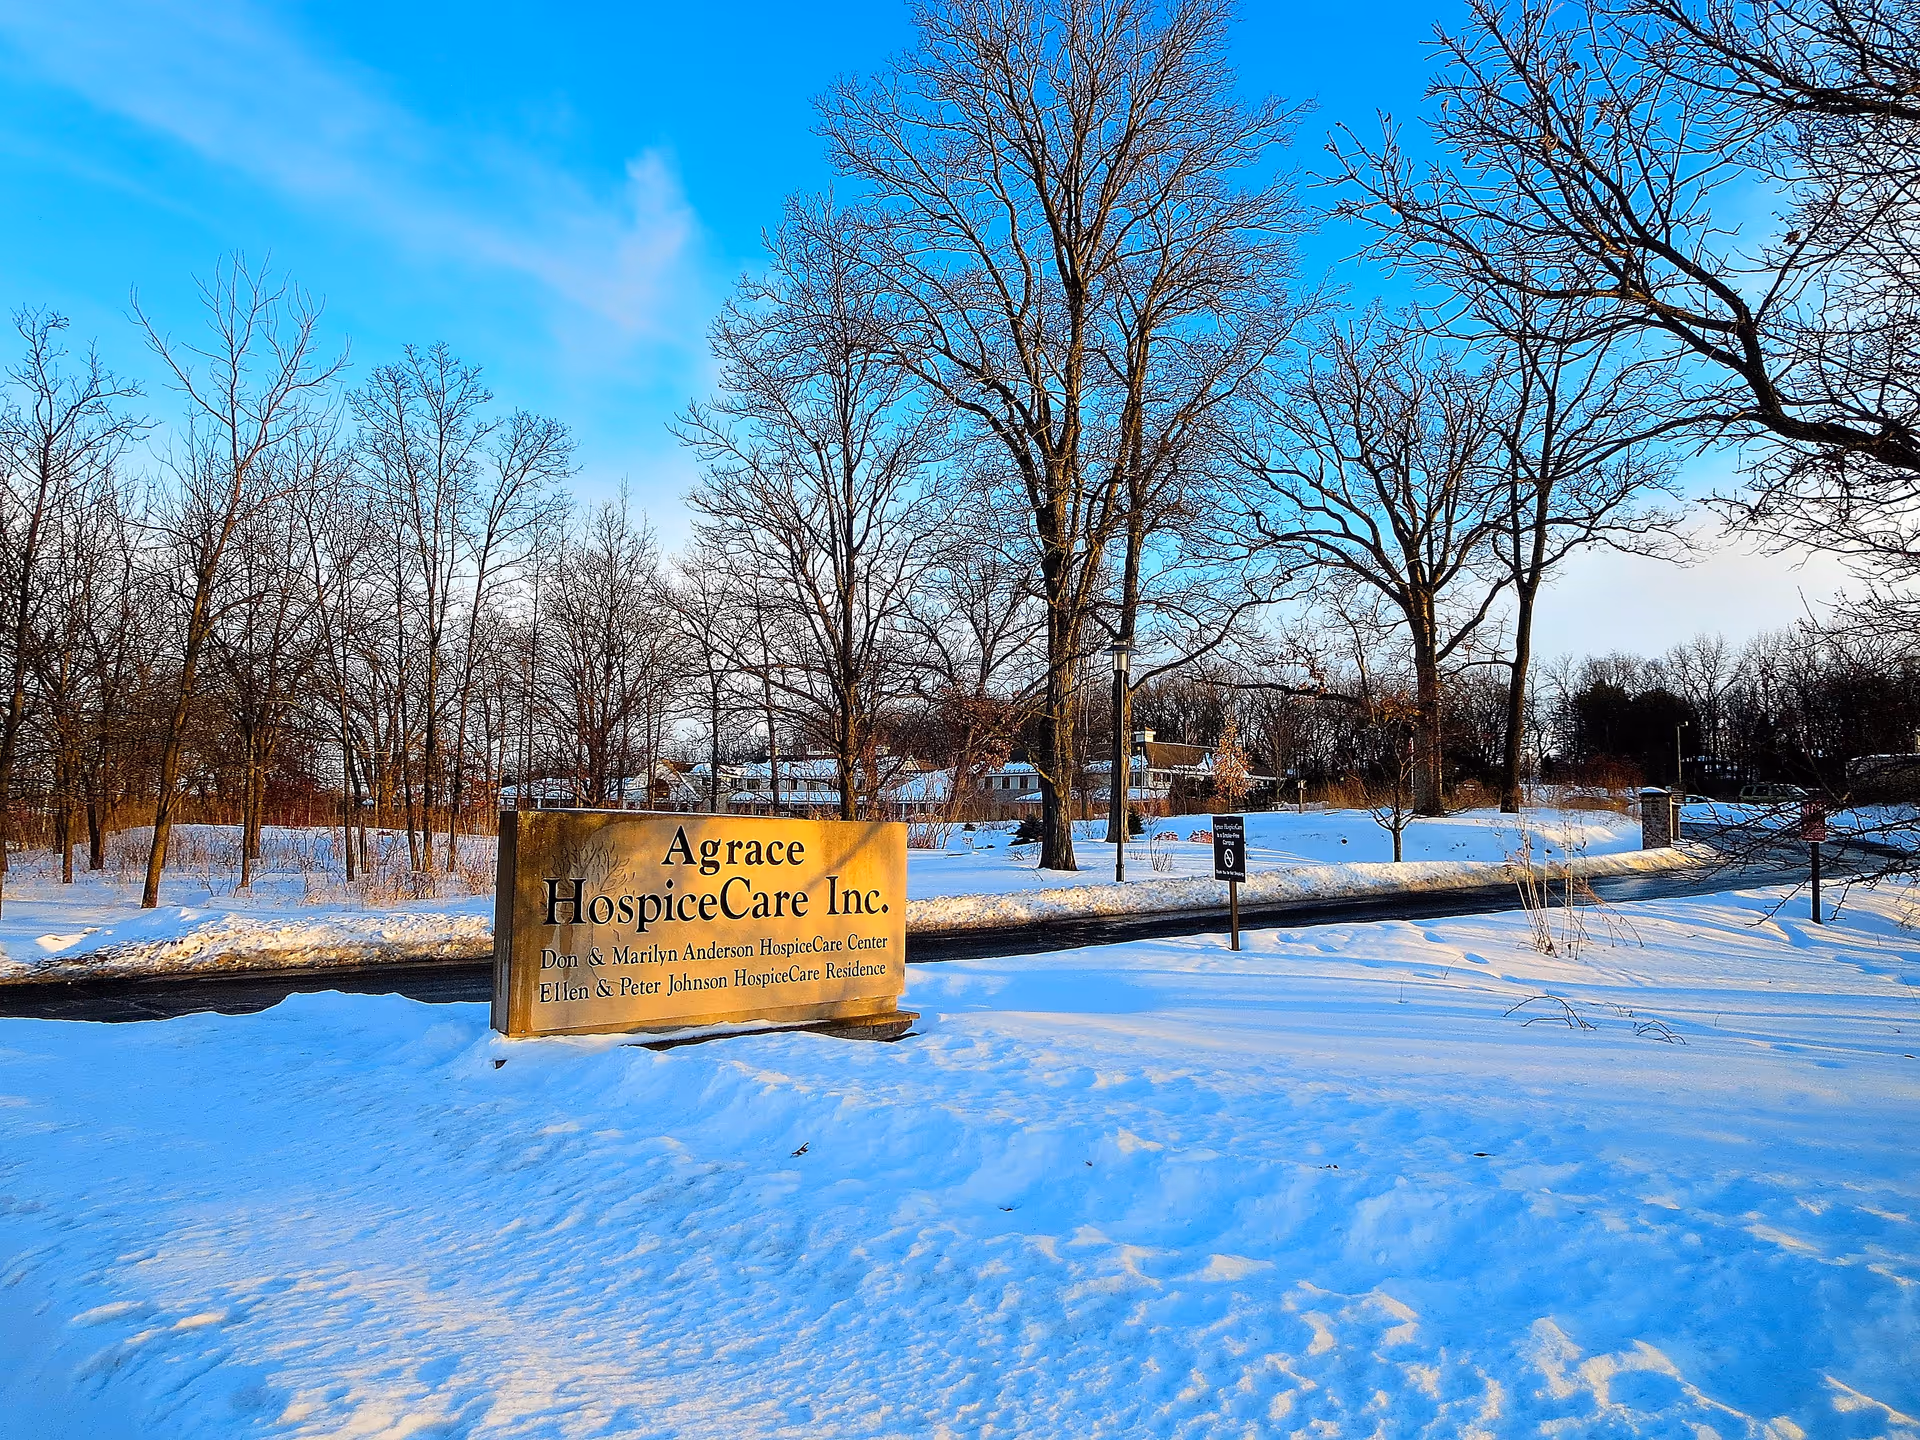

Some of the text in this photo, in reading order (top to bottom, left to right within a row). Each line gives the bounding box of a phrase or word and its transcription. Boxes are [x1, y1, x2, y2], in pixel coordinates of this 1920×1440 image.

[661, 825, 805, 875] Agrace
[542, 875, 890, 933] HospiceCare Inc.
[541, 935, 888, 969] Don & Marilyn Anderson HospiceCare Center
[540, 963, 886, 1003] Ellen & Peter Johnson HospiceCare Residence
